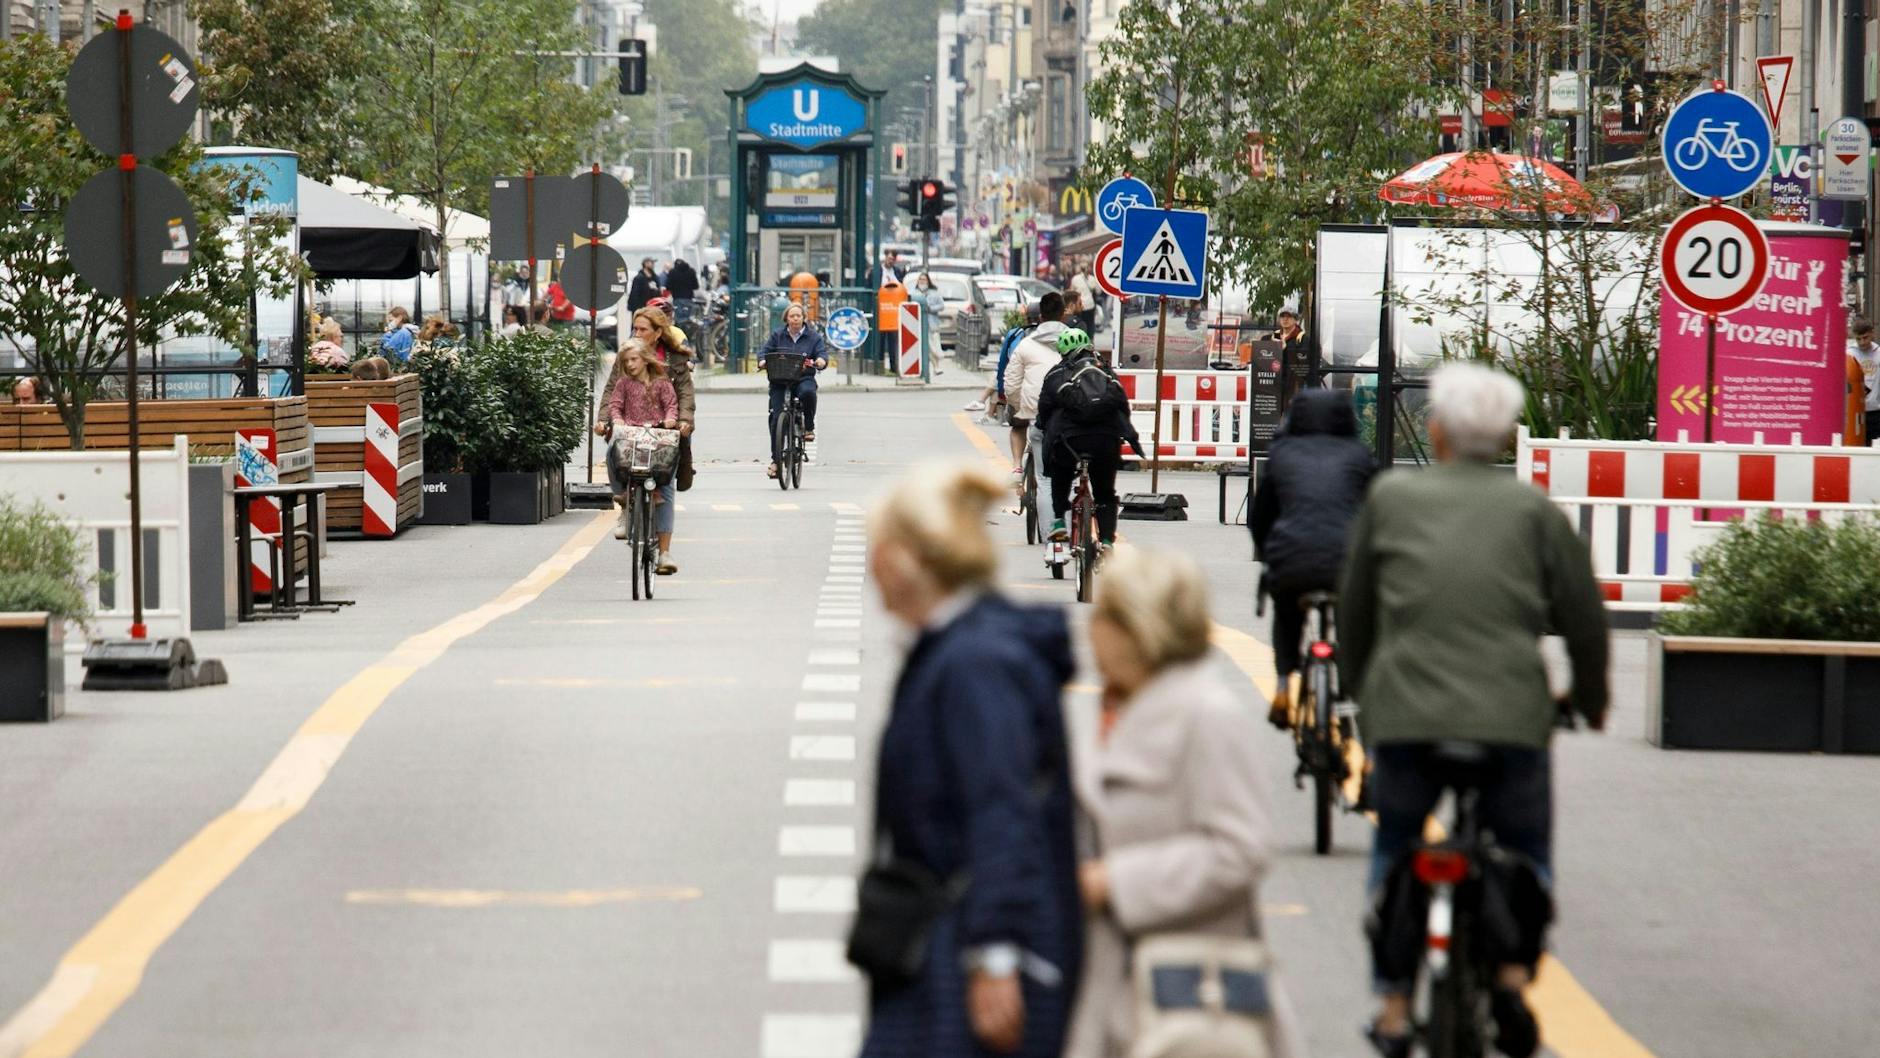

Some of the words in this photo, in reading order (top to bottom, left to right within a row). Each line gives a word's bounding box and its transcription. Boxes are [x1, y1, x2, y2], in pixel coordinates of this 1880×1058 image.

[793, 89, 819, 122] U
[769, 122, 842, 137] Stadtmitte
[1841, 124, 1854, 133] 30
[1109, 256, 1121, 279] 2
[1688, 236, 1742, 279] 20
[1677, 311, 1704, 338] 74
[1715, 316, 1819, 350] Prozent.
